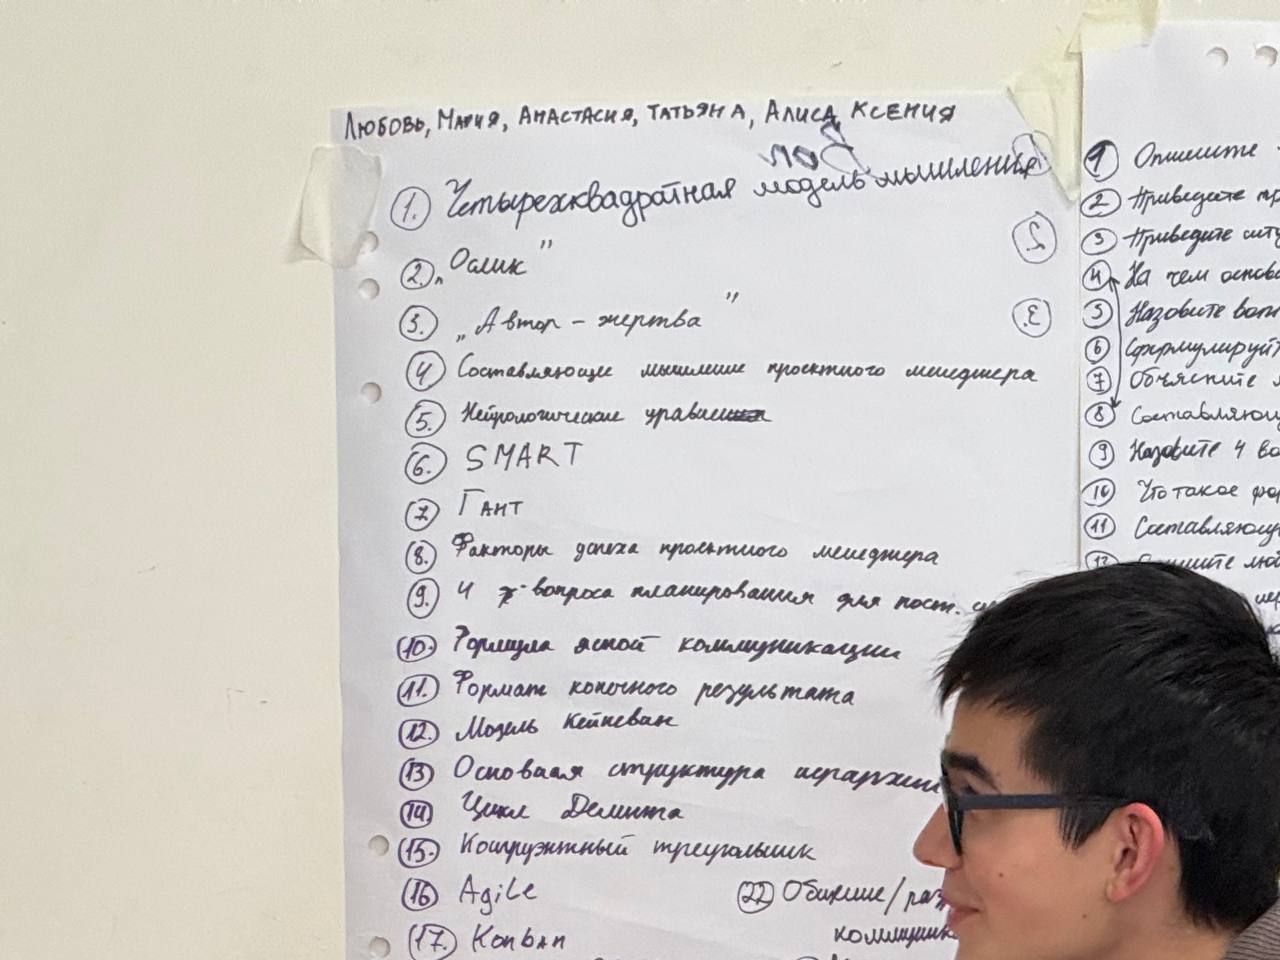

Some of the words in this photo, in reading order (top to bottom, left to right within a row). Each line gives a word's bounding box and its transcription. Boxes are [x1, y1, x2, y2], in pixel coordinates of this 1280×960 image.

[905, 364, 1039, 391] менеджера
[465, 441, 584, 472] SMART
[452, 669, 548, 705] Формат
[693, 682, 856, 708] результата
